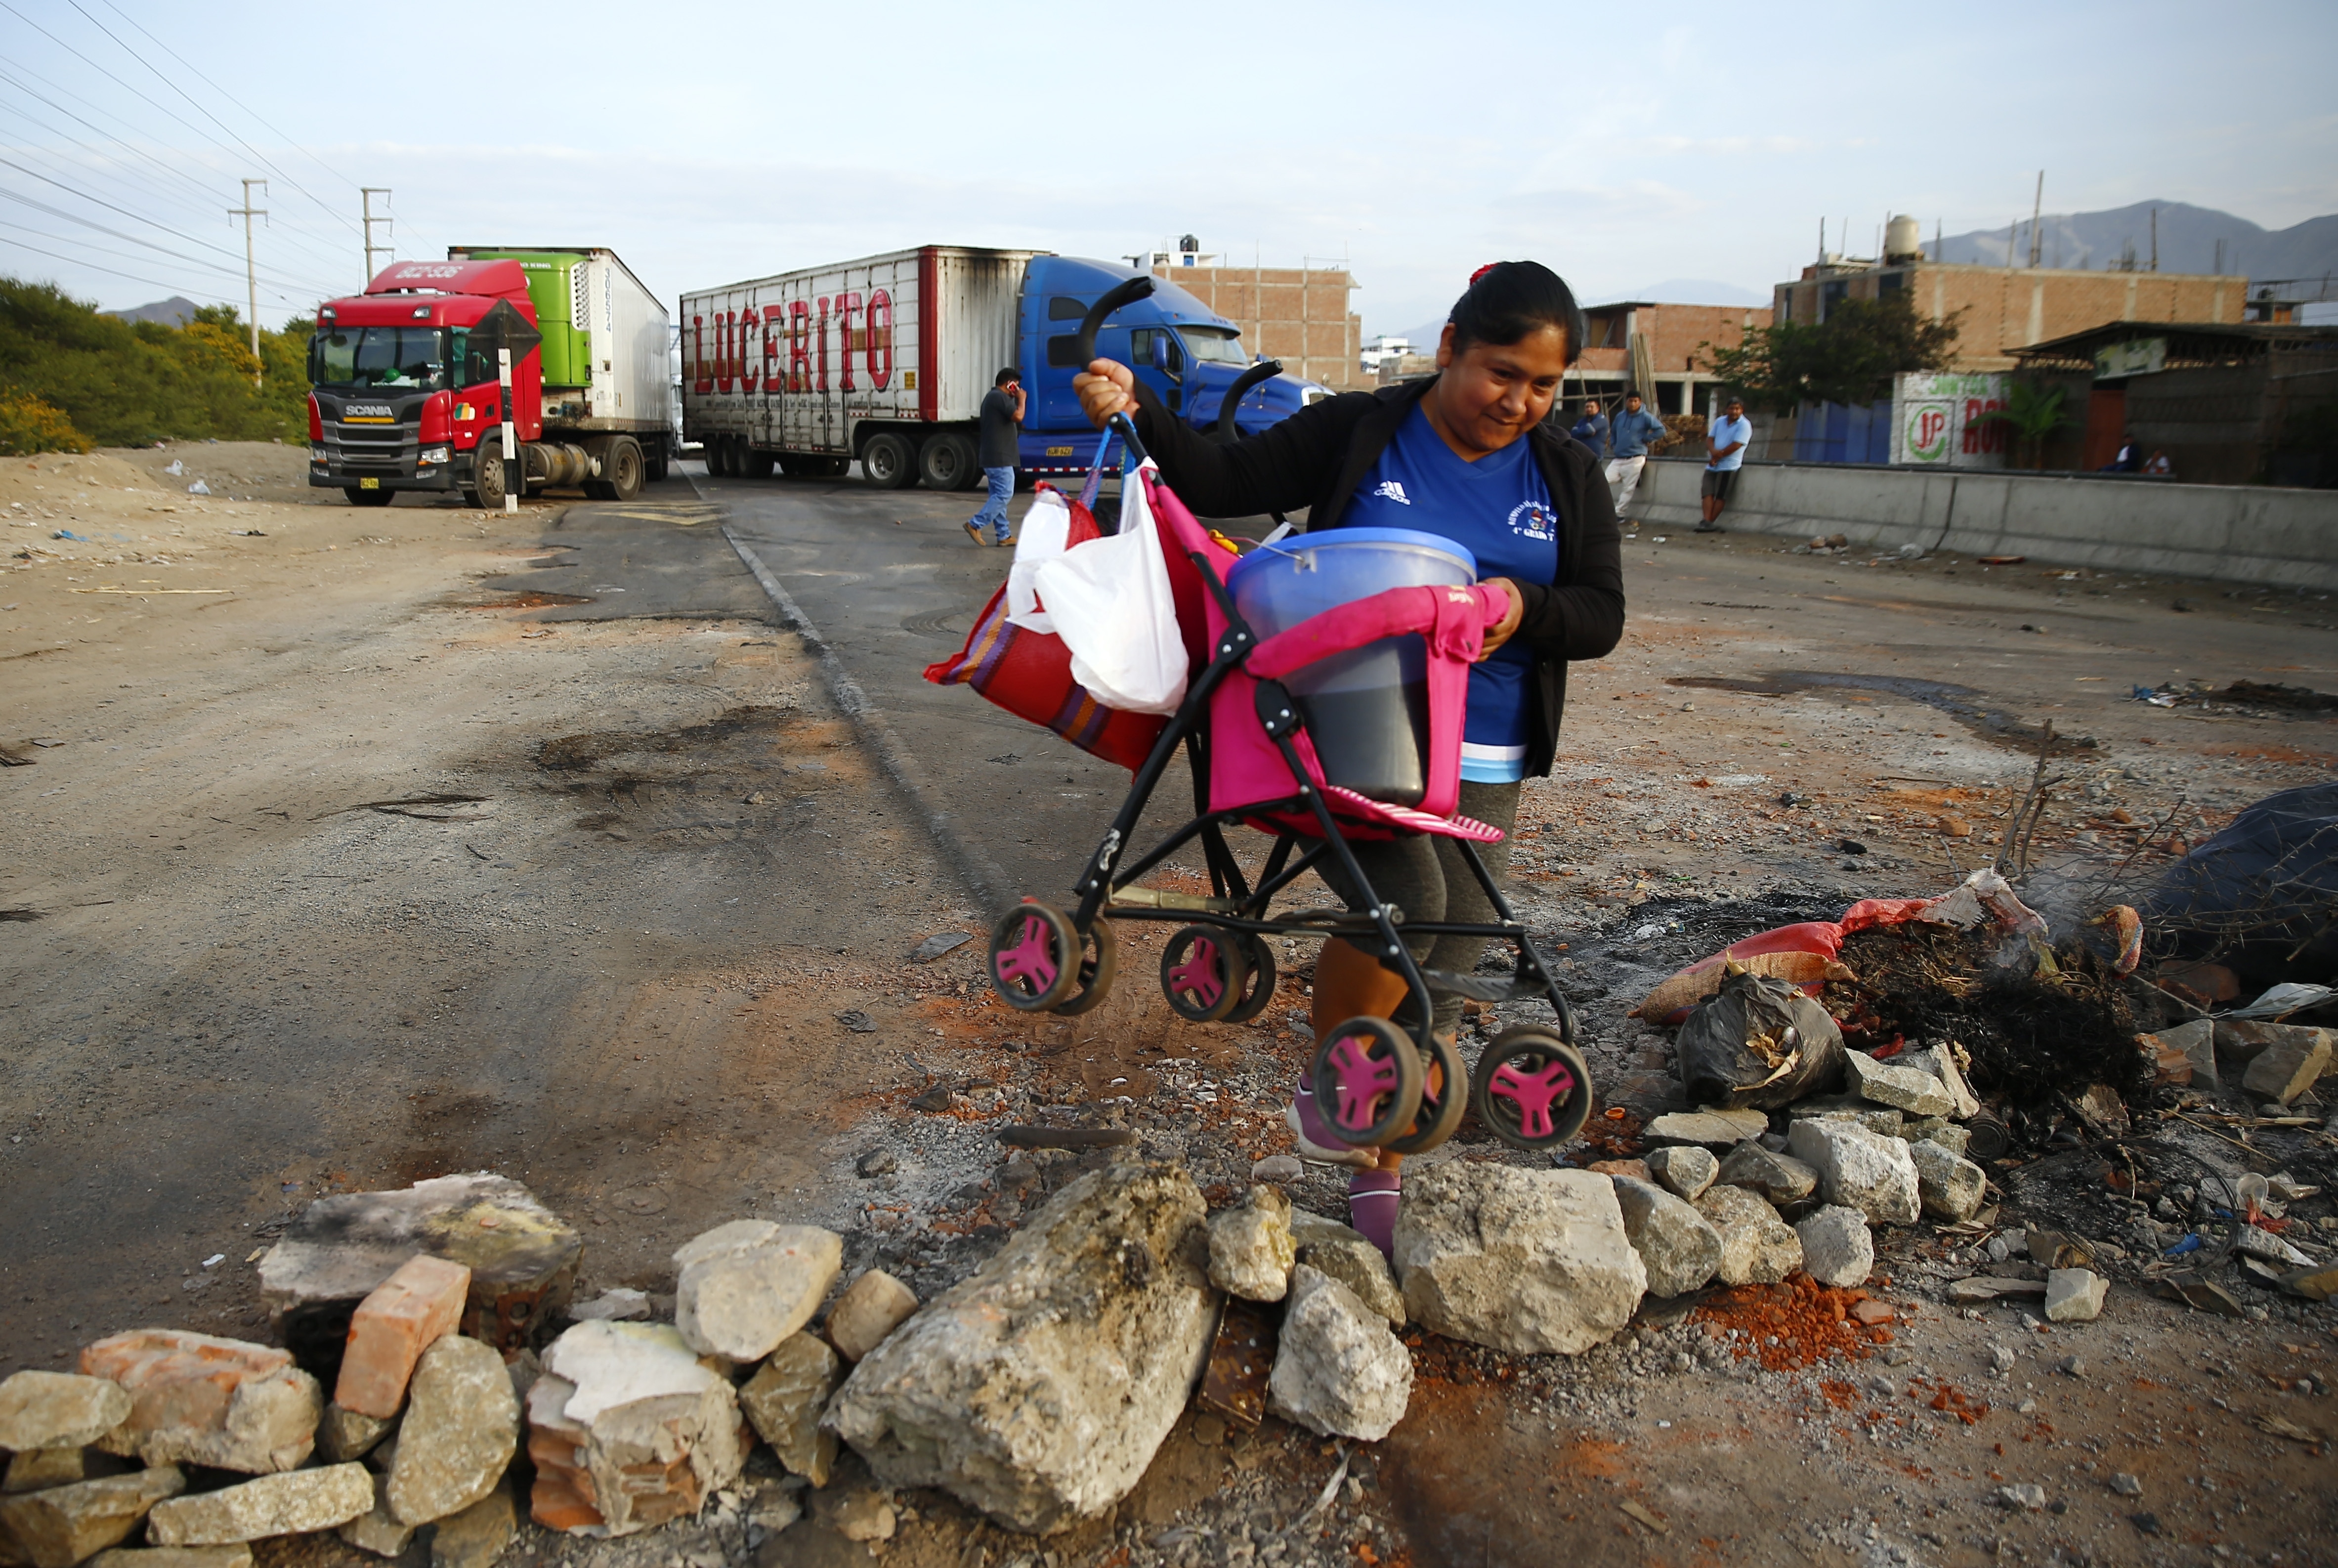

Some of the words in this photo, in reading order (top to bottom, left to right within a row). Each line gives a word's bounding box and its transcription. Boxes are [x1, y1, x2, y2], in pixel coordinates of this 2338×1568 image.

[693, 288, 892, 394] LUCERITO
[346, 405, 393, 416] SCANIA
[1374, 488, 1411, 506] adidas
